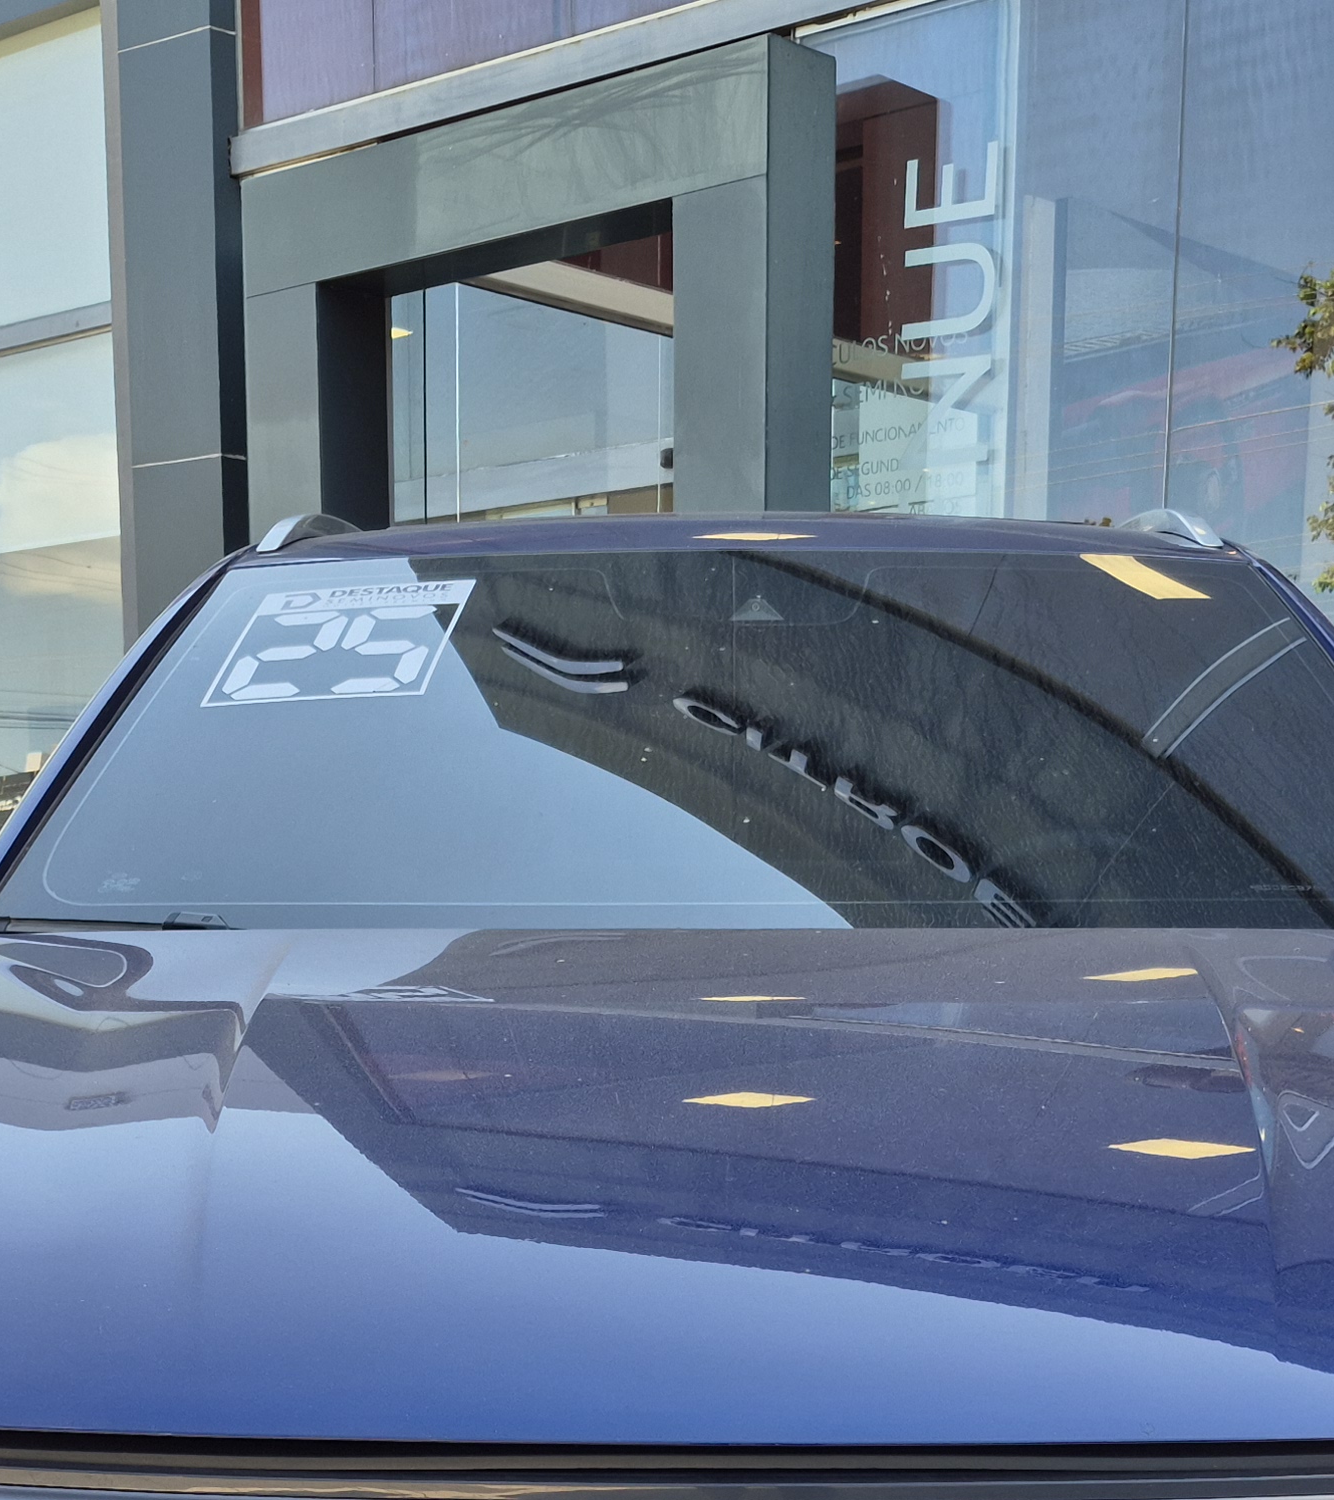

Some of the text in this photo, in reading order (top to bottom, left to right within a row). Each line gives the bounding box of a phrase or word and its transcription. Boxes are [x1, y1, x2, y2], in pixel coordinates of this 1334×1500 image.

[847, 482, 871, 499] DAS
[874, 478, 911, 496] 08:00
[329, 583, 454, 598] DESTAQUE
[222, 605, 437, 700] 25
